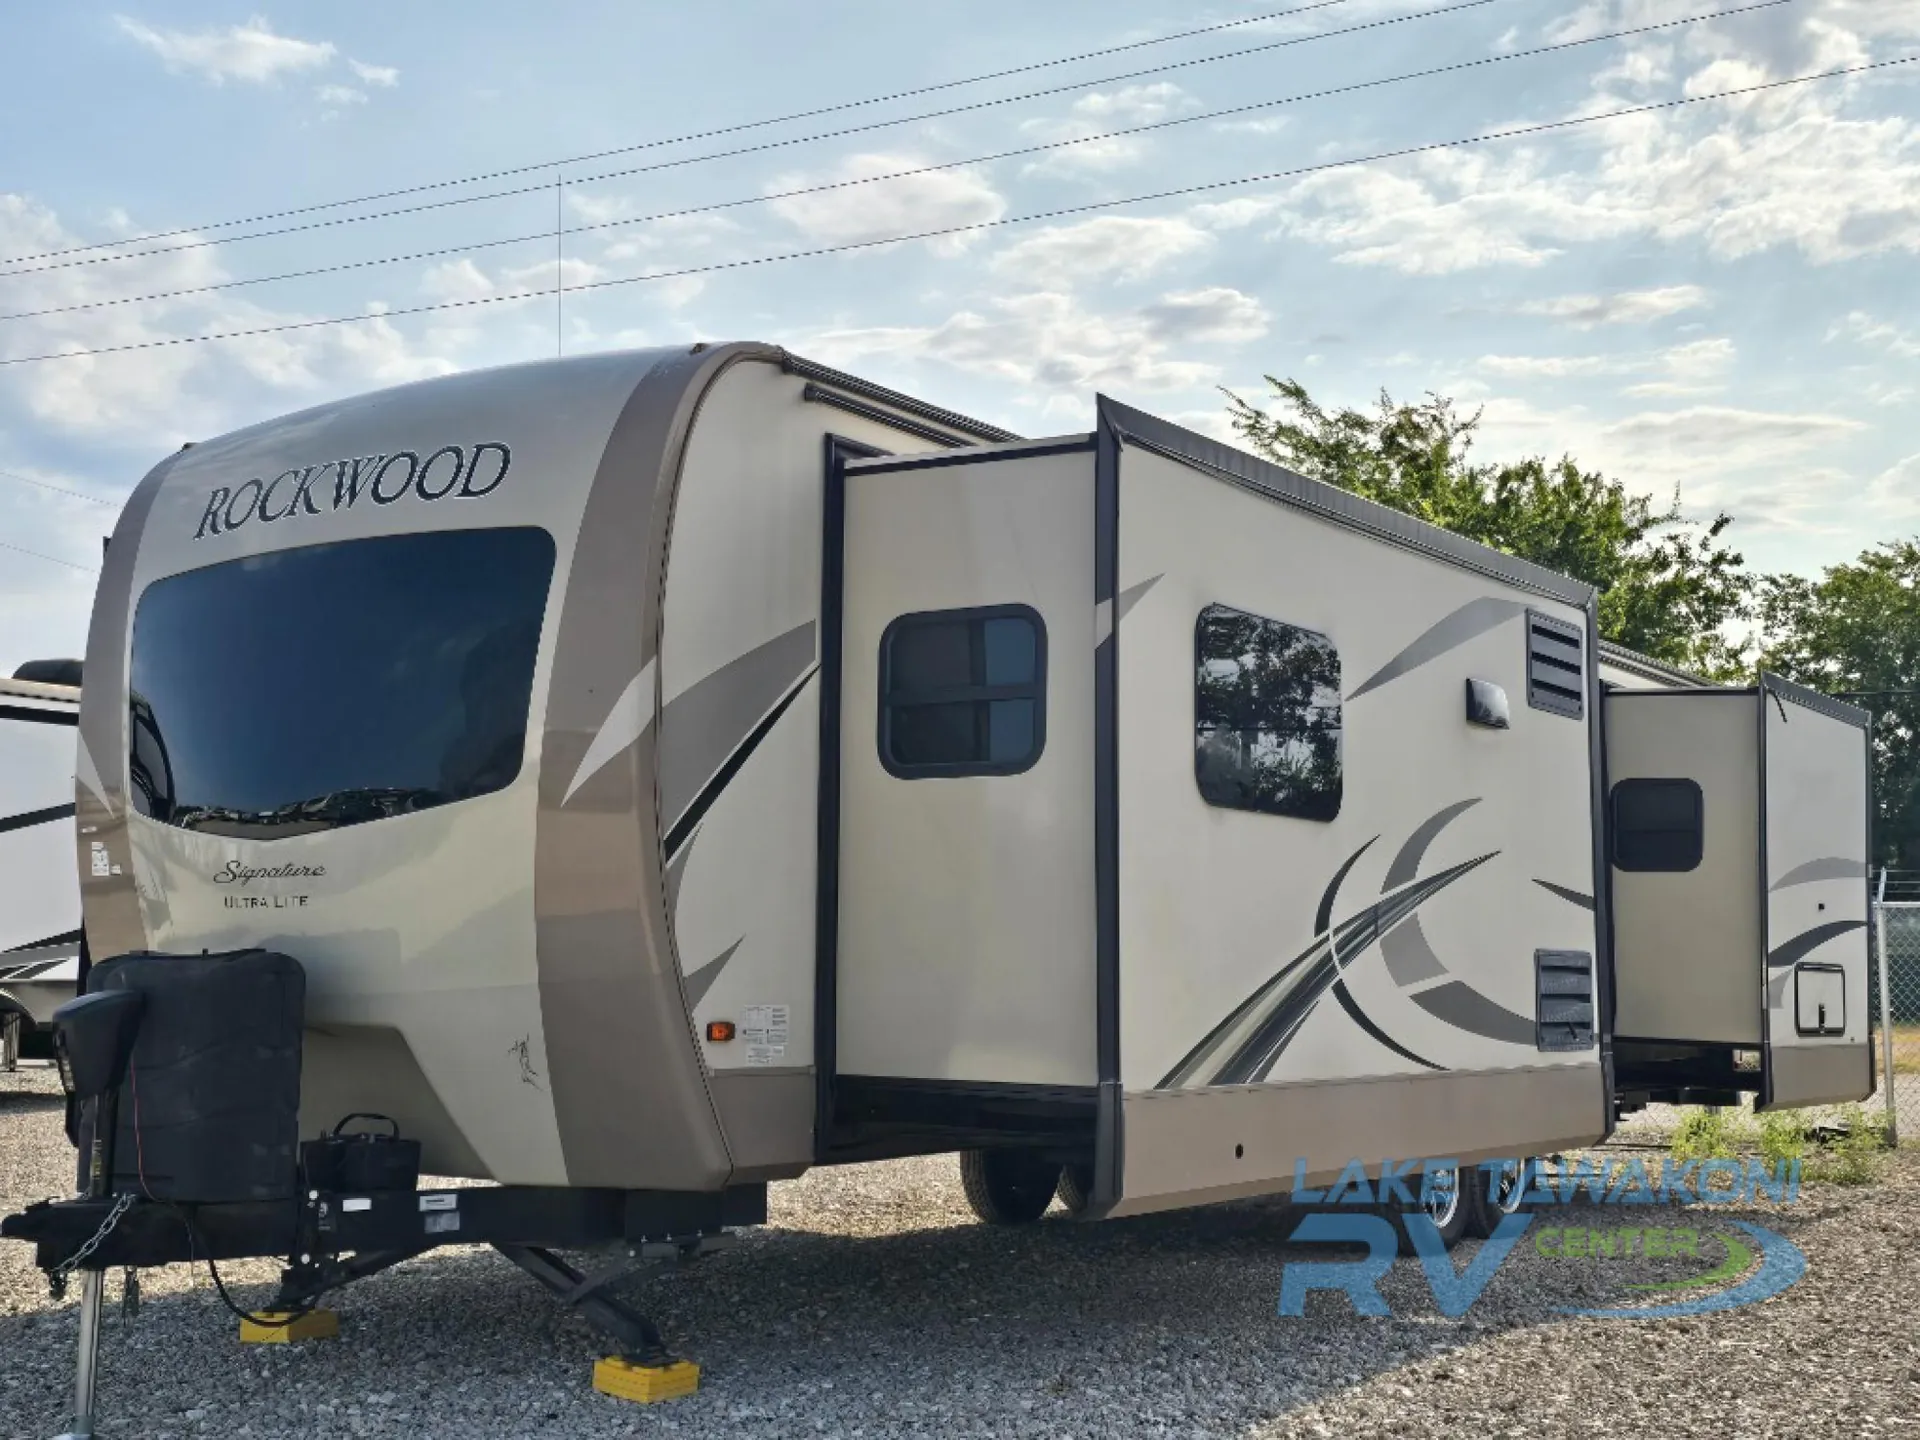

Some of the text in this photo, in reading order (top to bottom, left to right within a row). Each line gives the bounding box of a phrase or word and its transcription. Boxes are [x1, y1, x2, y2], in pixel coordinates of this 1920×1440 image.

[194, 442, 511, 540] ROCKWOOD
[213, 860, 326, 887] Signature
[224, 895, 308, 909] ULTRA LITE
